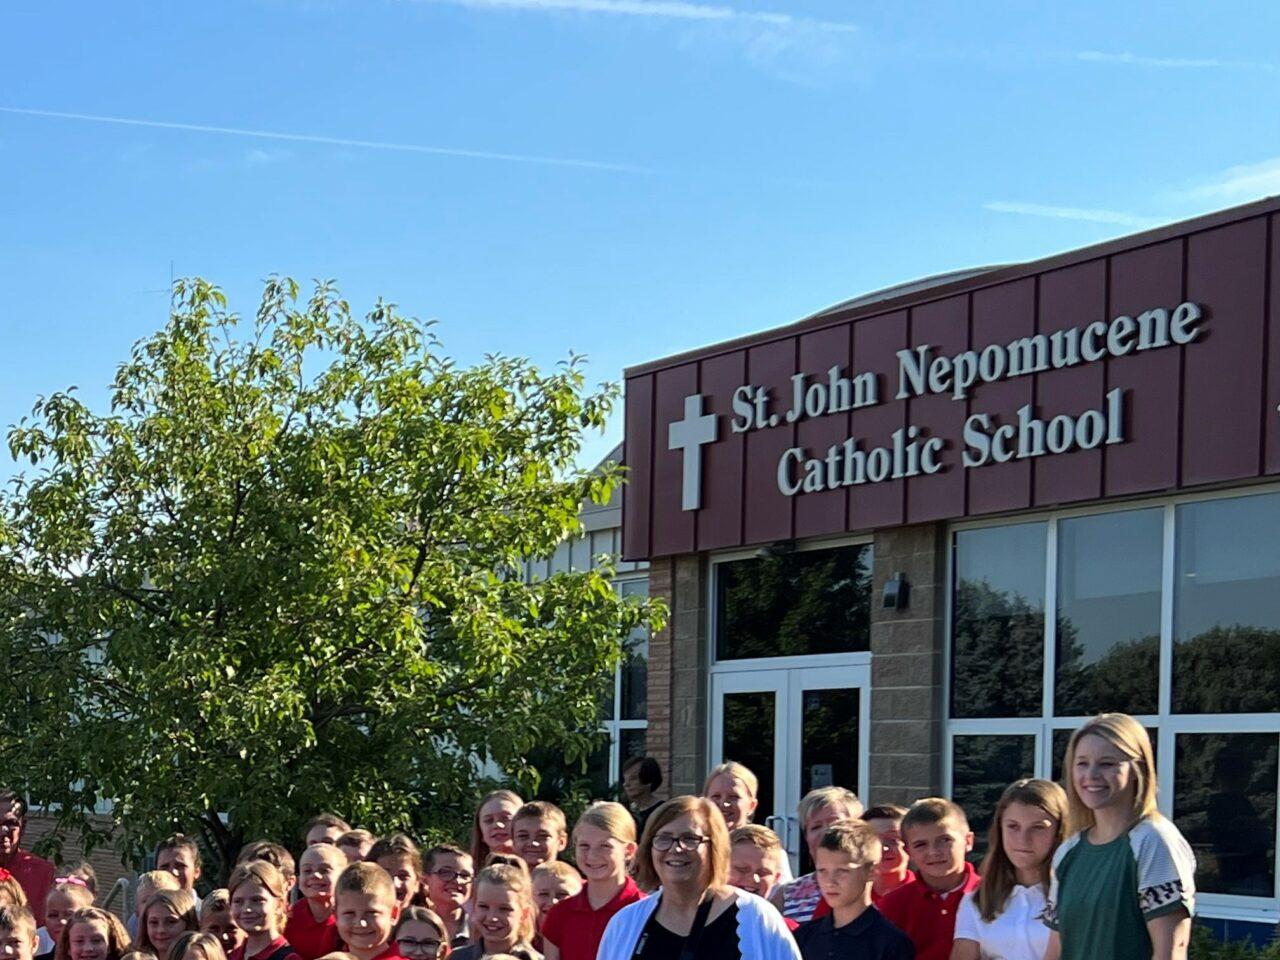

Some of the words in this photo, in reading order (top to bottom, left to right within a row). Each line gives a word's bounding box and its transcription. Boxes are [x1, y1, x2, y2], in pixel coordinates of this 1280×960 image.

[730, 384, 779, 434] St.
[786, 365, 877, 423] John
[895, 301, 1201, 401] Nepomucene
[776, 424, 943, 497] Catholic
[961, 387, 1123, 468] School
